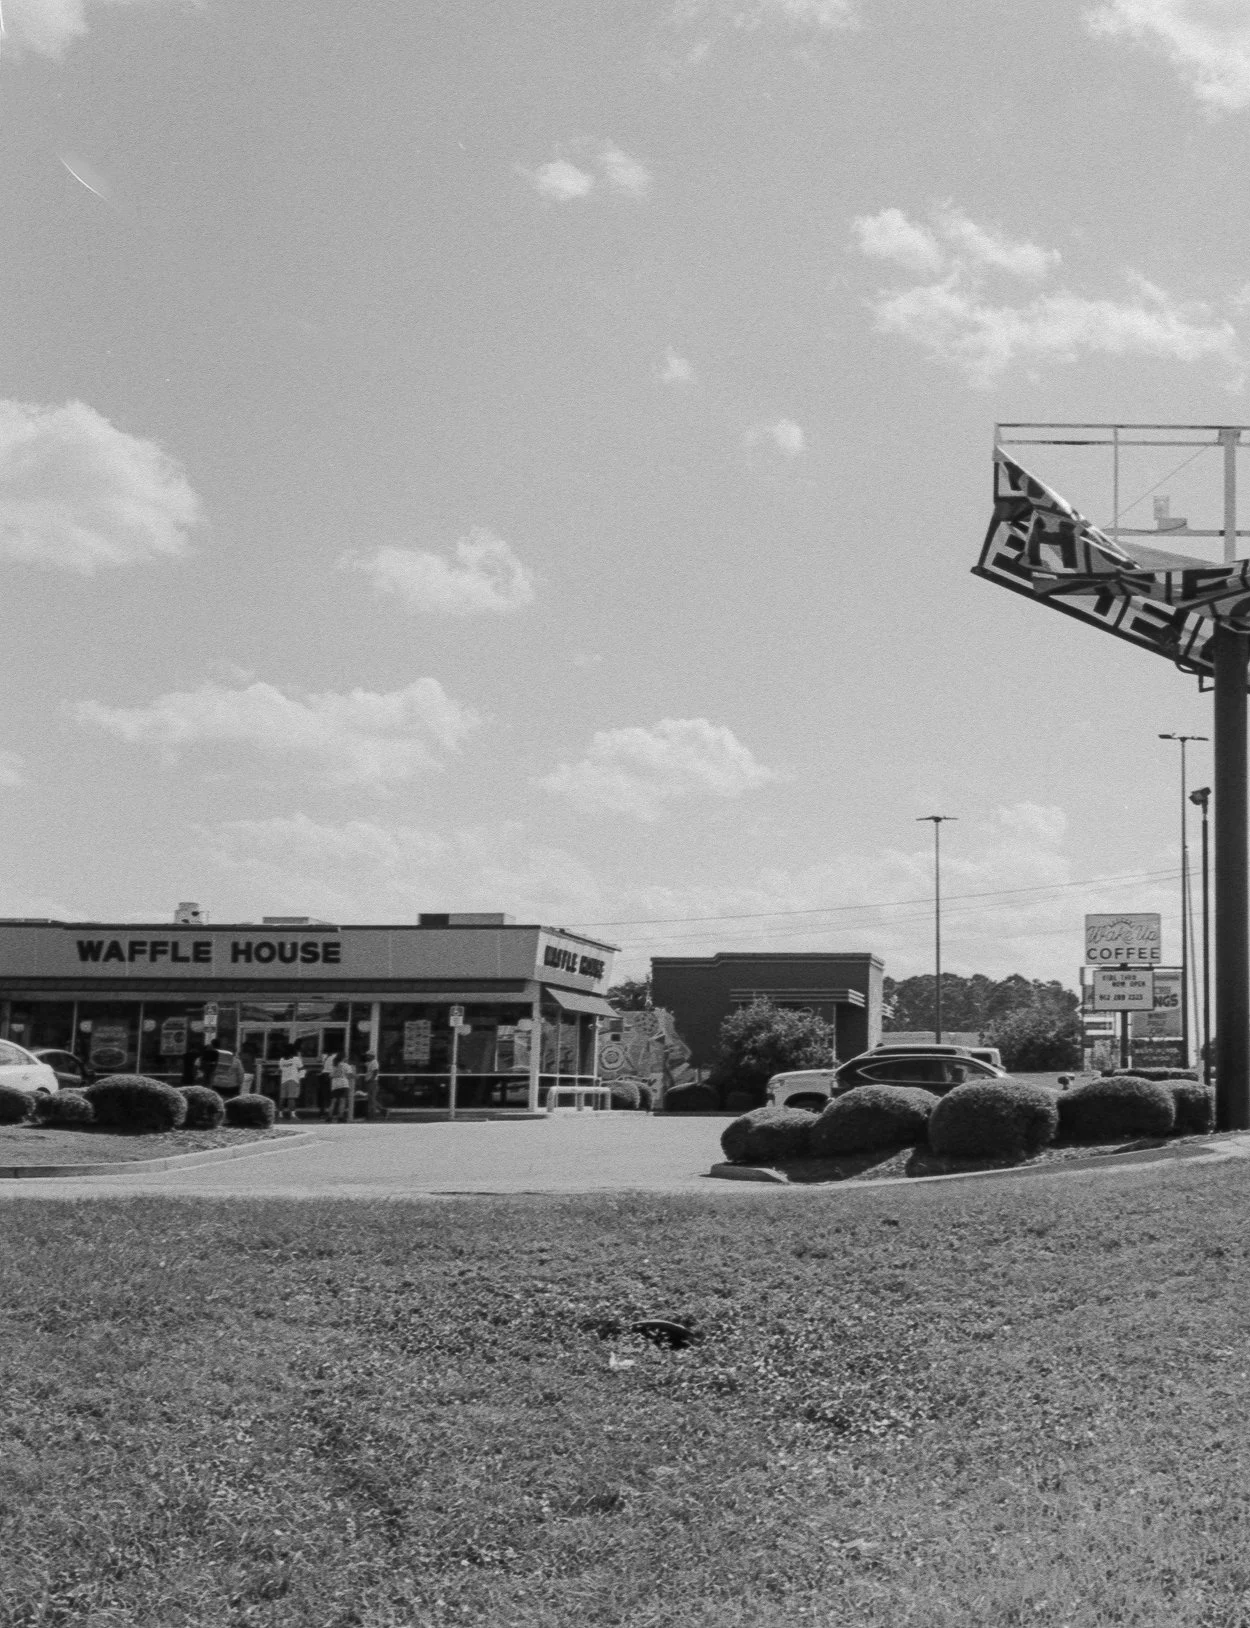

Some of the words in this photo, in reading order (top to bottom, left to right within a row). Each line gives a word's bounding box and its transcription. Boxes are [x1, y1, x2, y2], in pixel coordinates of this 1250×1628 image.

[1087, 925, 1134, 945] Wake
[76, 940, 212, 963] WAFFLE
[231, 941, 341, 964] HOUSE
[1087, 948, 1160, 960] COFFEE
[1153, 993, 1179, 1008] NGS
